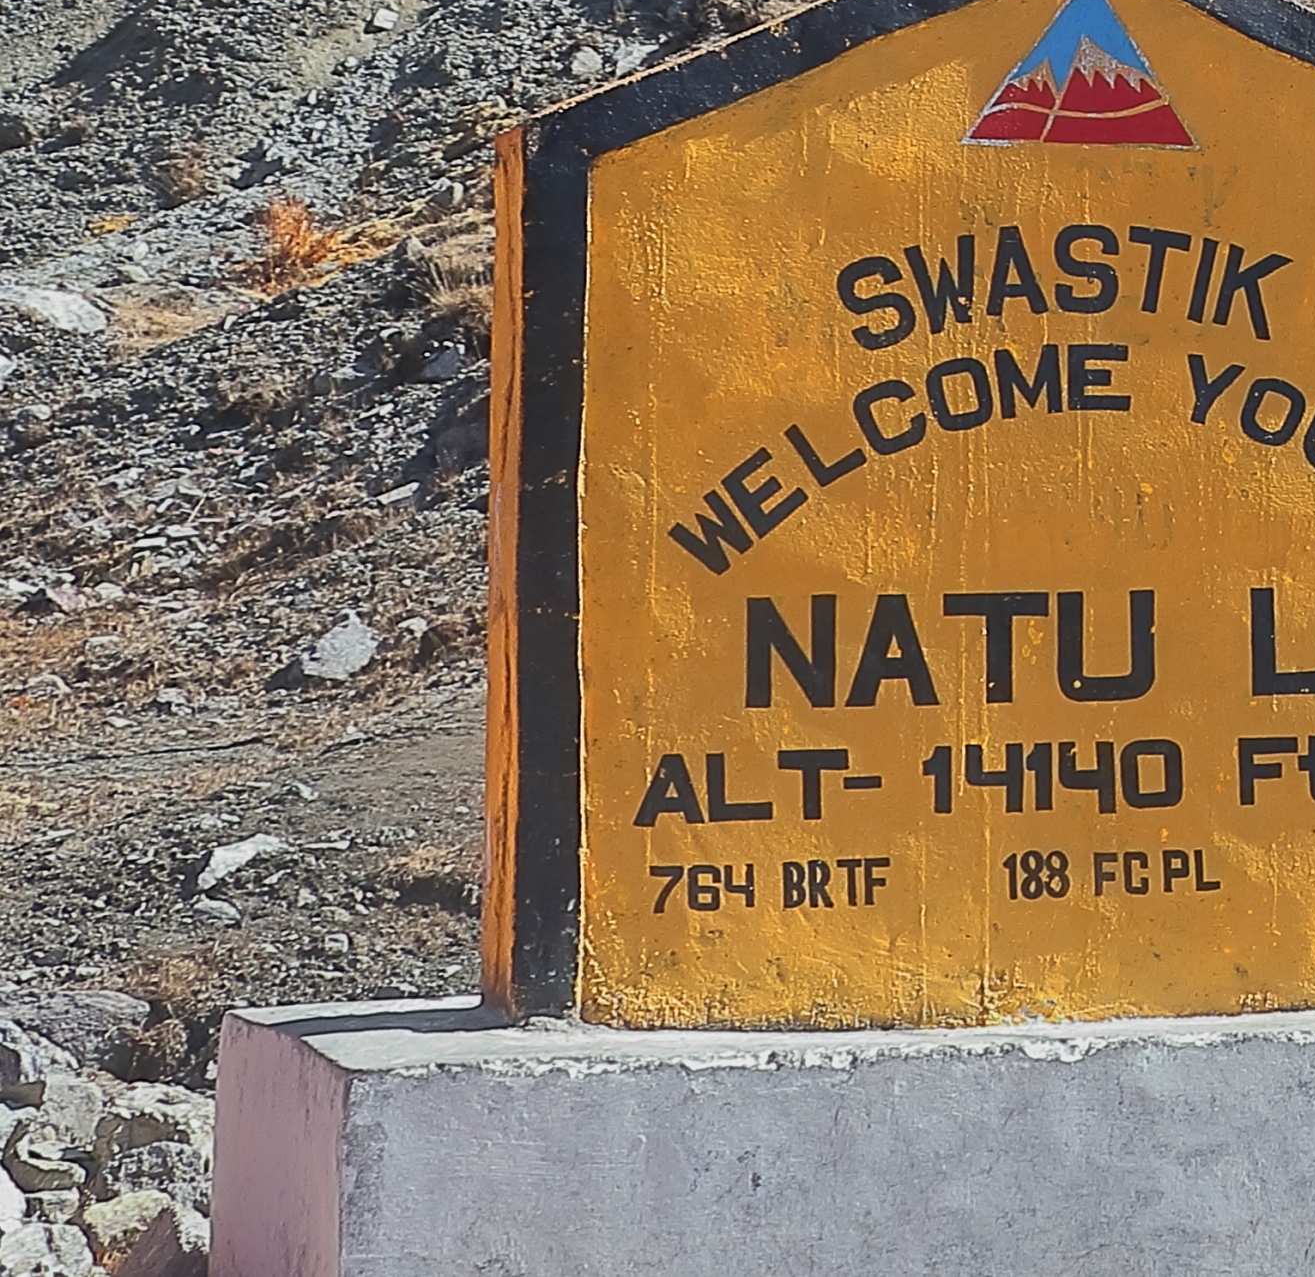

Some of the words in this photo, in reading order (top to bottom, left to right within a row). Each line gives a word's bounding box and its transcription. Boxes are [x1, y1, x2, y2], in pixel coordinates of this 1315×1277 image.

[835, 223, 1295, 352] SWASTIK
[666, 342, 1133, 577] WELCOME
[744, 588, 1157, 710] NATU
[632, 747, 883, 829] ALT-
[921, 737, 1185, 816] 14140
[648, 862, 756, 915] 764
[781, 857, 892, 910] BRTF
[1001, 849, 1071, 901] 188
